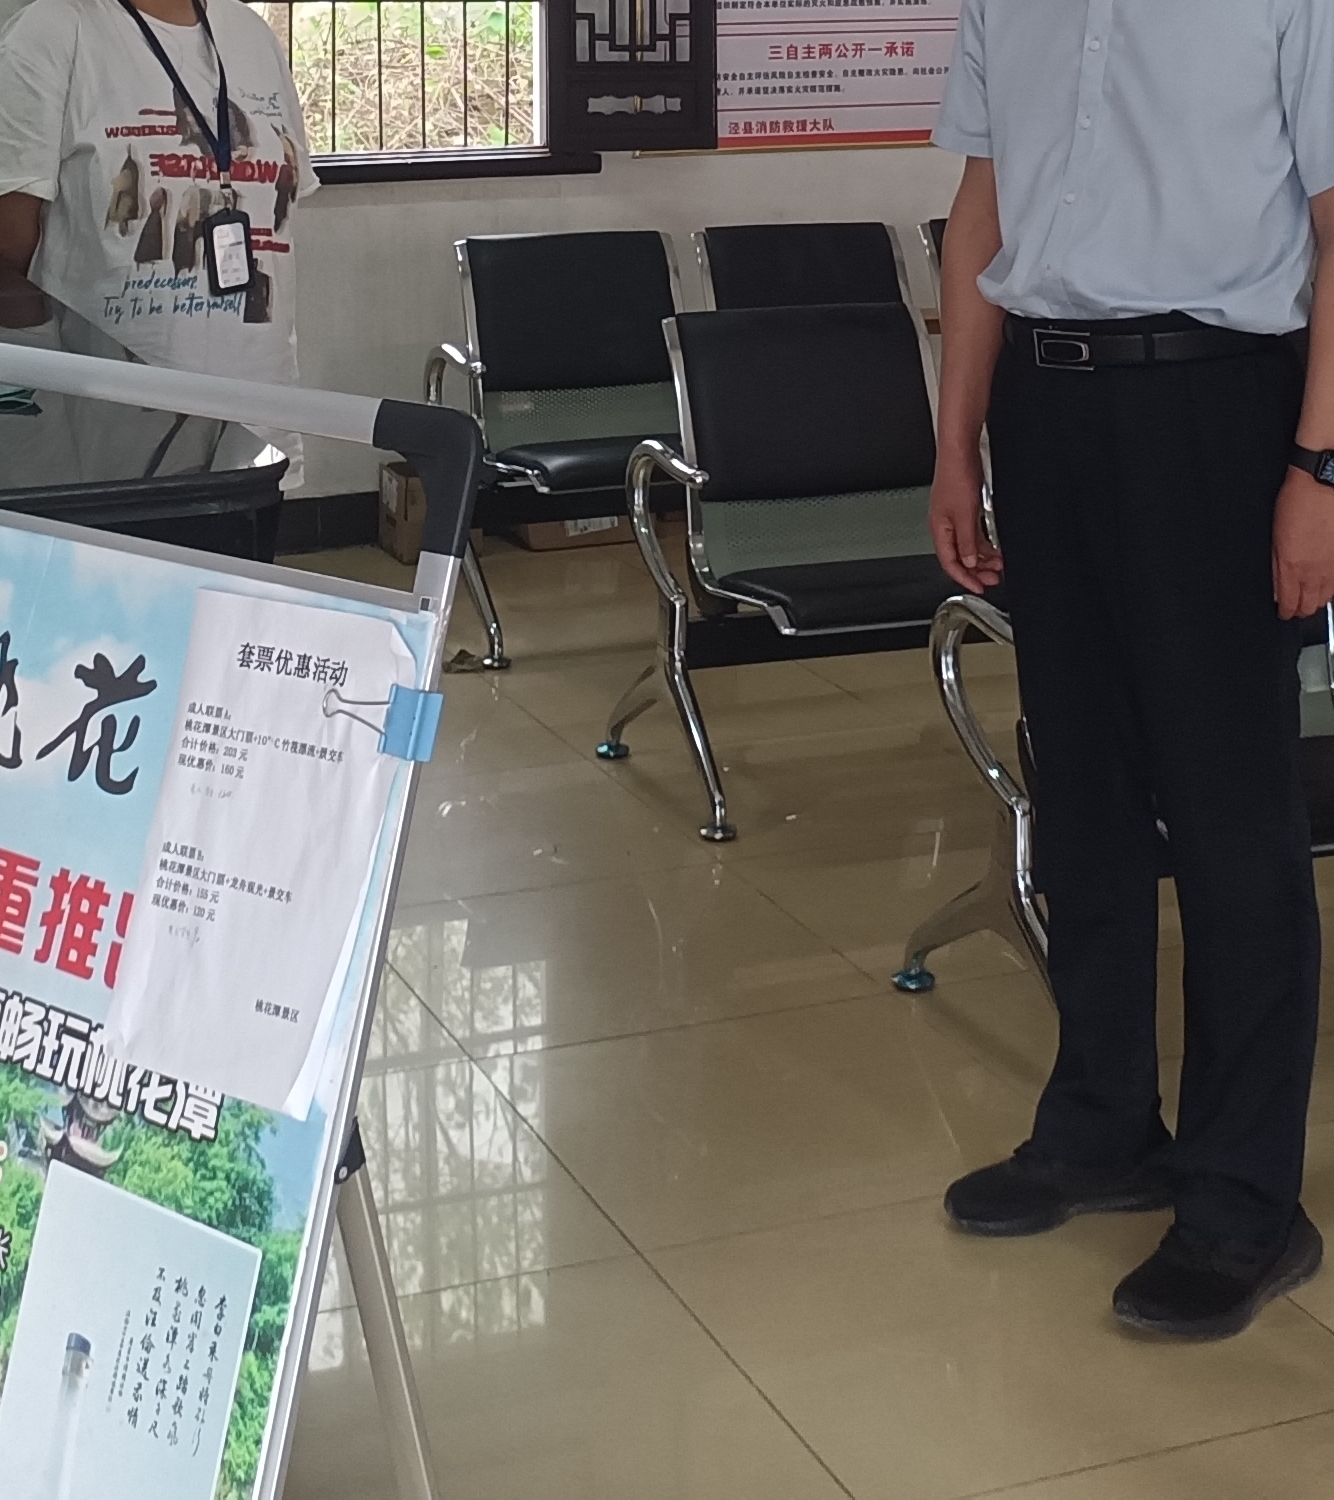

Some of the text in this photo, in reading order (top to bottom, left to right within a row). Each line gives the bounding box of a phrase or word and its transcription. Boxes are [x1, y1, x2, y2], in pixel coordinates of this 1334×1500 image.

[768, 41, 915, 61] 三自主两公开一承诺
[728, 118, 835, 135] 泾县消防救援大队
[236, 641, 349, 688] 套票优惠活动
